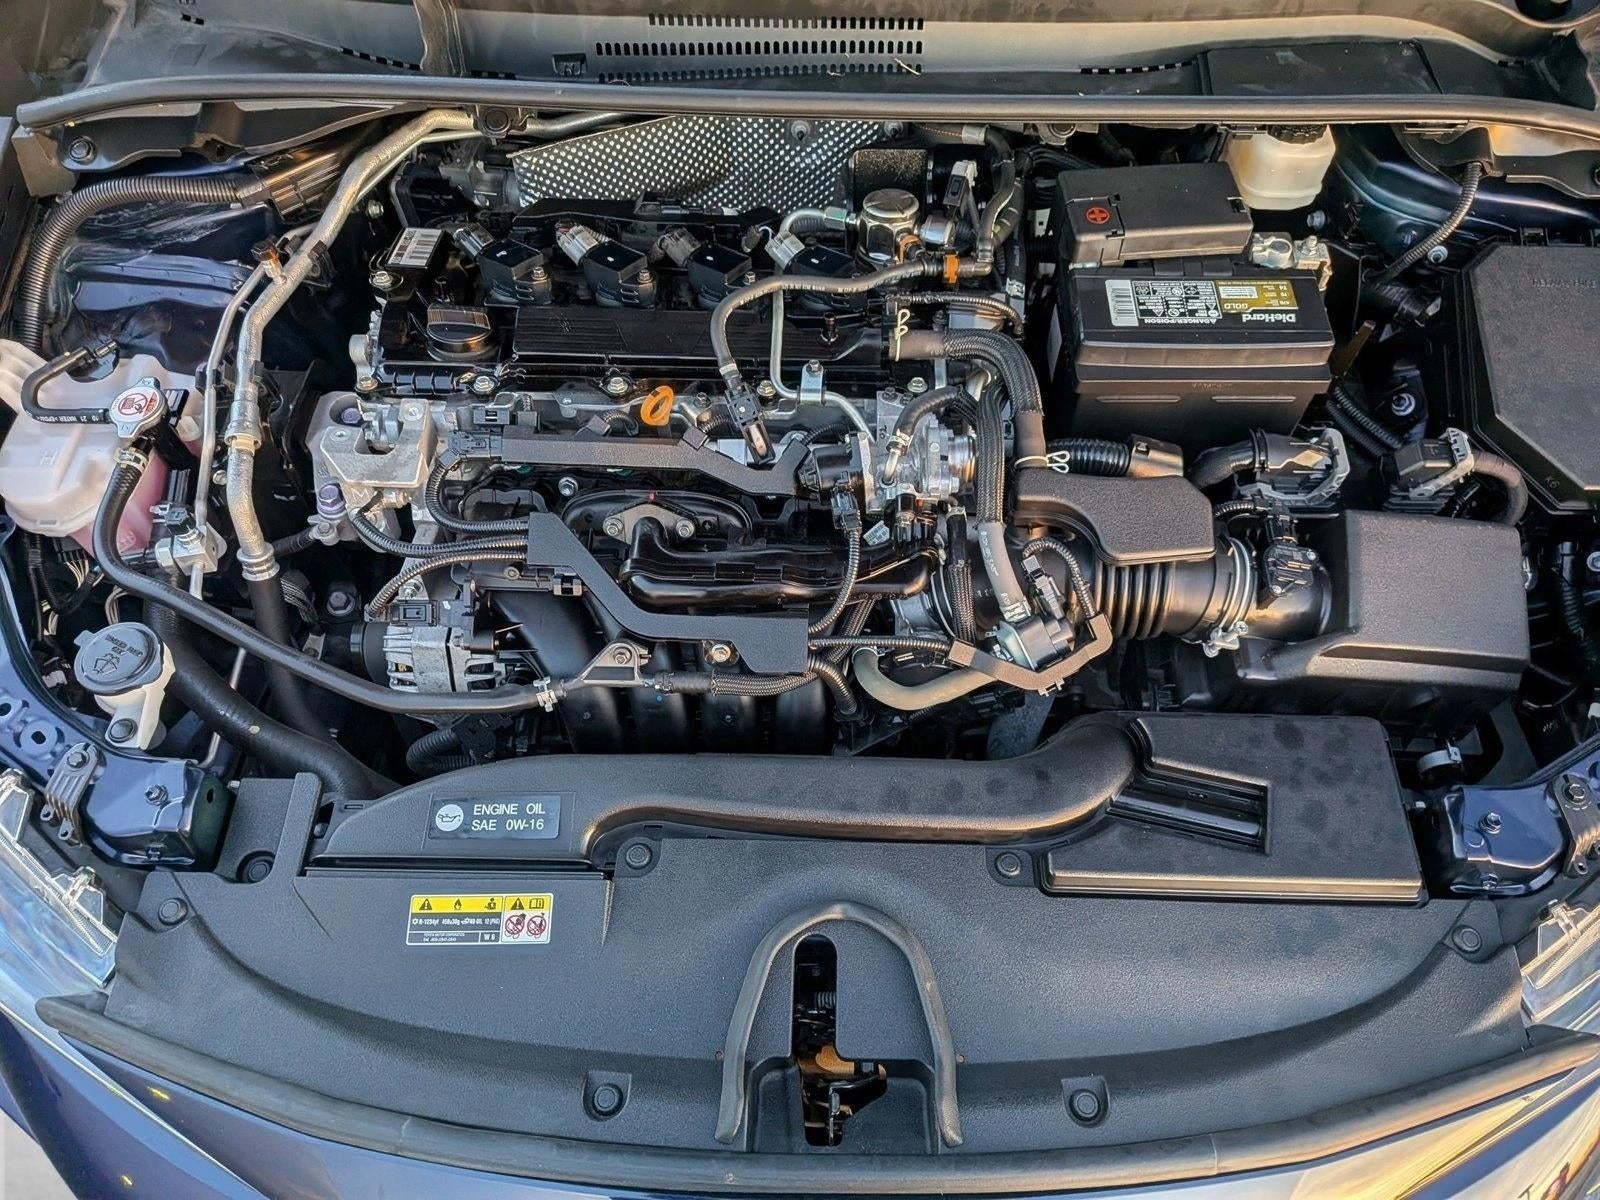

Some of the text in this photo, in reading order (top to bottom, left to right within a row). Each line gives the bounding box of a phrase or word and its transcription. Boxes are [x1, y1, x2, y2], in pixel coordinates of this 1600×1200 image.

[1241, 313, 1297, 323] DieHard
[473, 802, 546, 816] ENGINE OIL
[471, 818, 545, 831] SAE 0W-16
